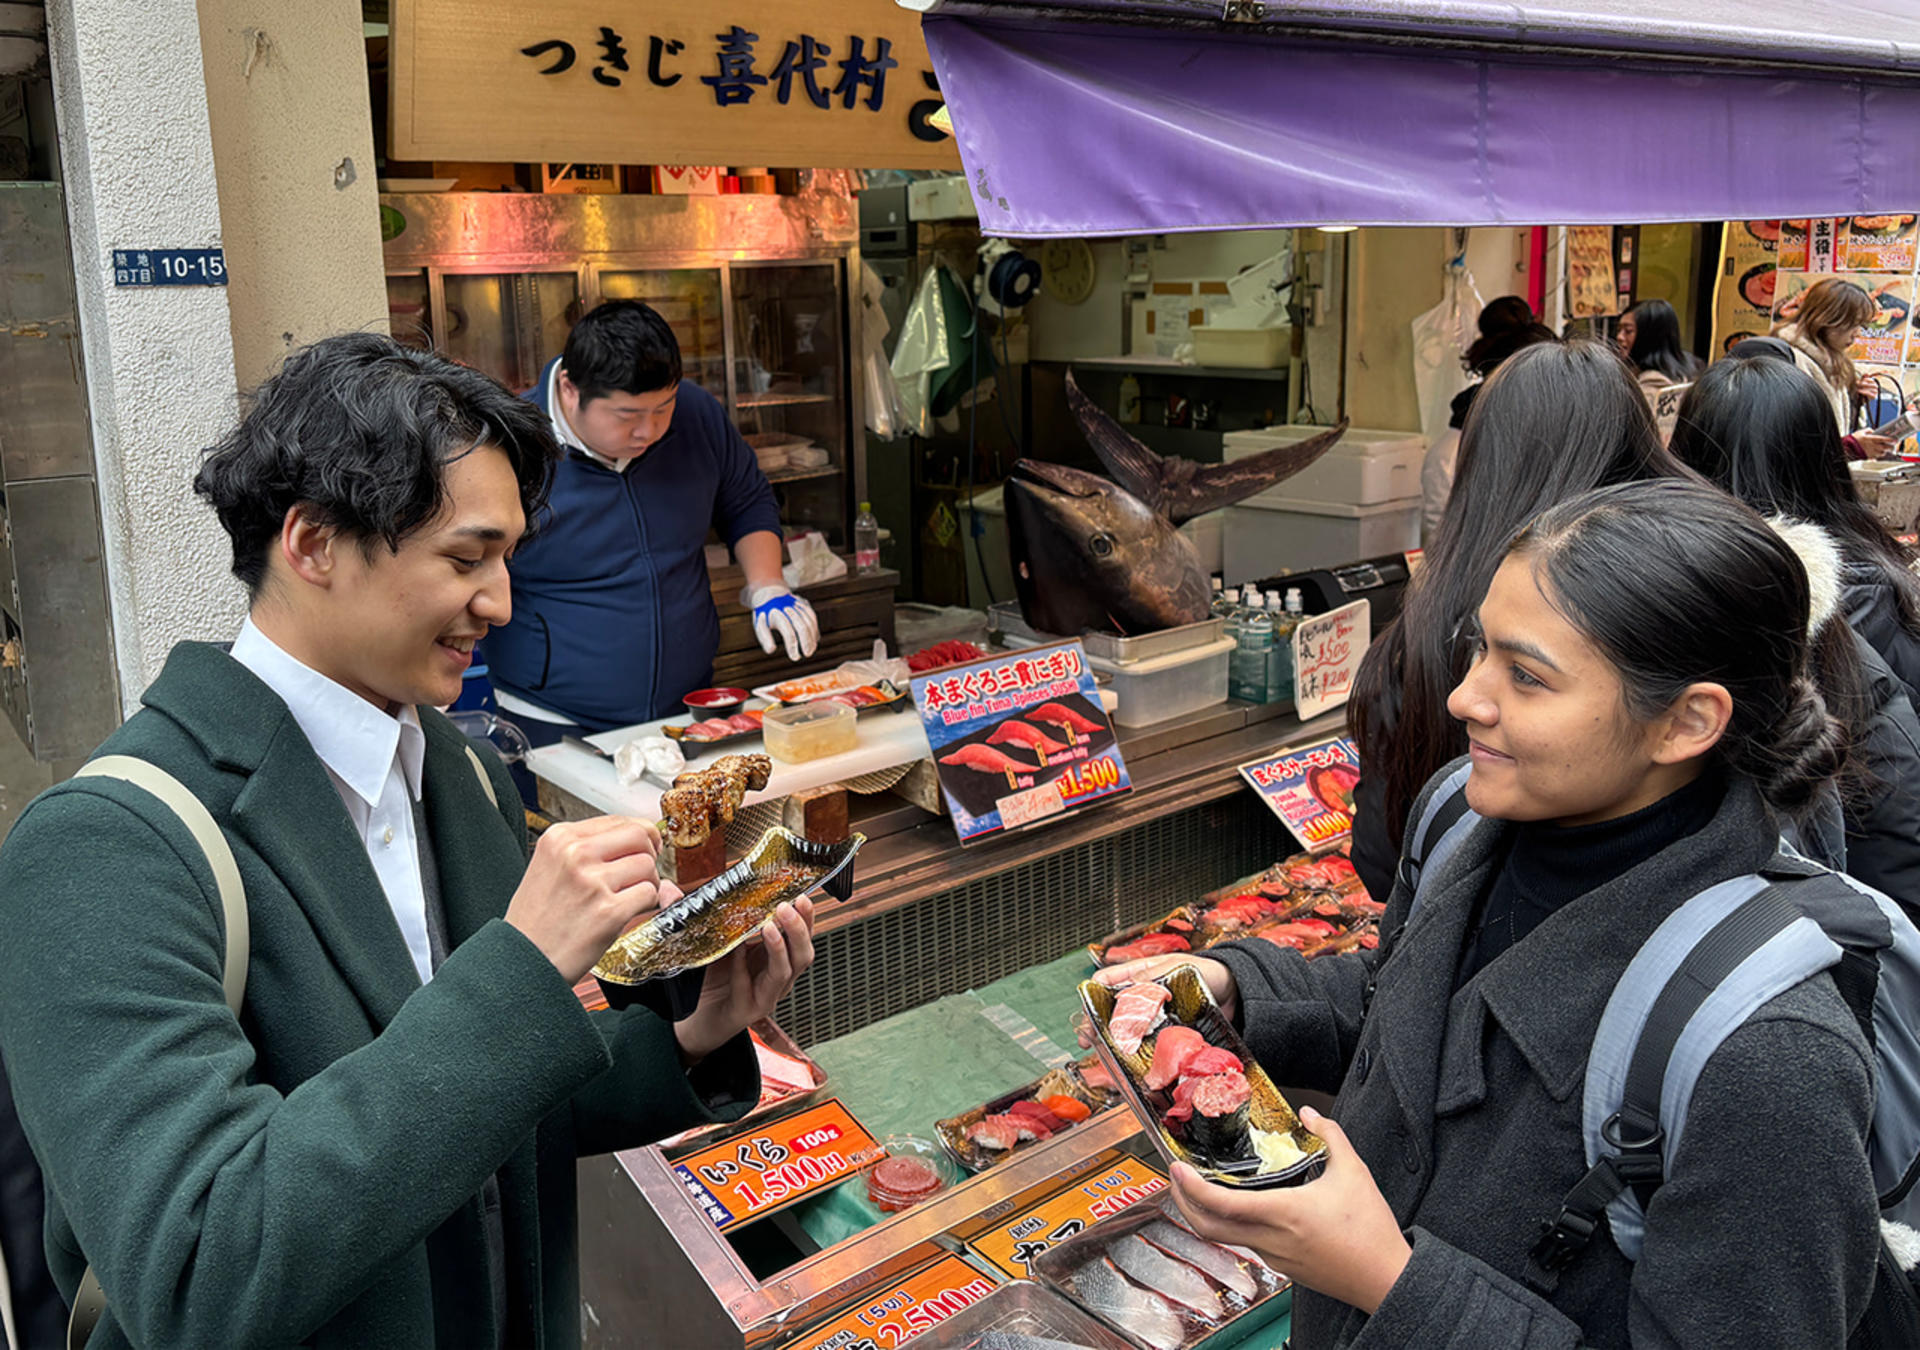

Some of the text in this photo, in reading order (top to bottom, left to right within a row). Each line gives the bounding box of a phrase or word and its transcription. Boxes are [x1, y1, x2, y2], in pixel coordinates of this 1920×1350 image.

[116, 269, 151, 283] 四丁目
[161, 256, 223, 278] 10-15
[924, 649, 1081, 709] 本まぐろ三貫にぎり
[942, 708, 968, 725] Blue
[985, 698, 1012, 714] Tuna
[796, 1128, 839, 1150] 100g
[698, 1137, 790, 1185] いくら
[734, 1151, 848, 1211] 1,500円
